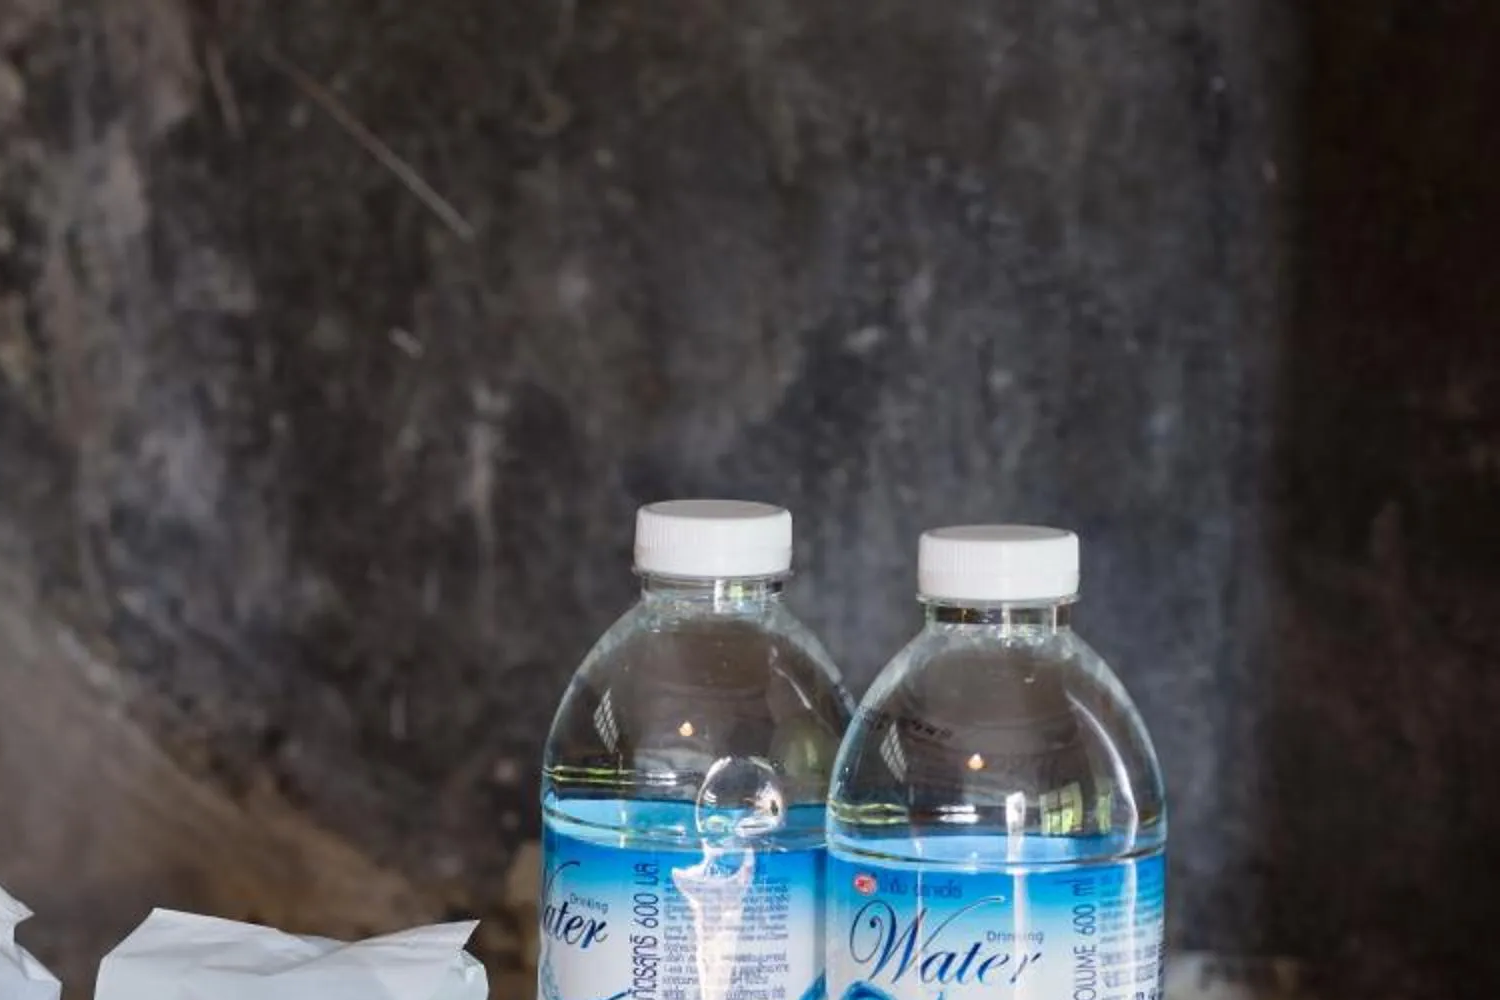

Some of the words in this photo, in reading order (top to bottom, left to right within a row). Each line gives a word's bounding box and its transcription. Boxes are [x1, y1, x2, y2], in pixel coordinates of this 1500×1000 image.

[633, 893, 660, 929] 600
[1072, 903, 1097, 936] 600
[850, 895, 1042, 985] Water
[986, 930, 1045, 945] Drining
